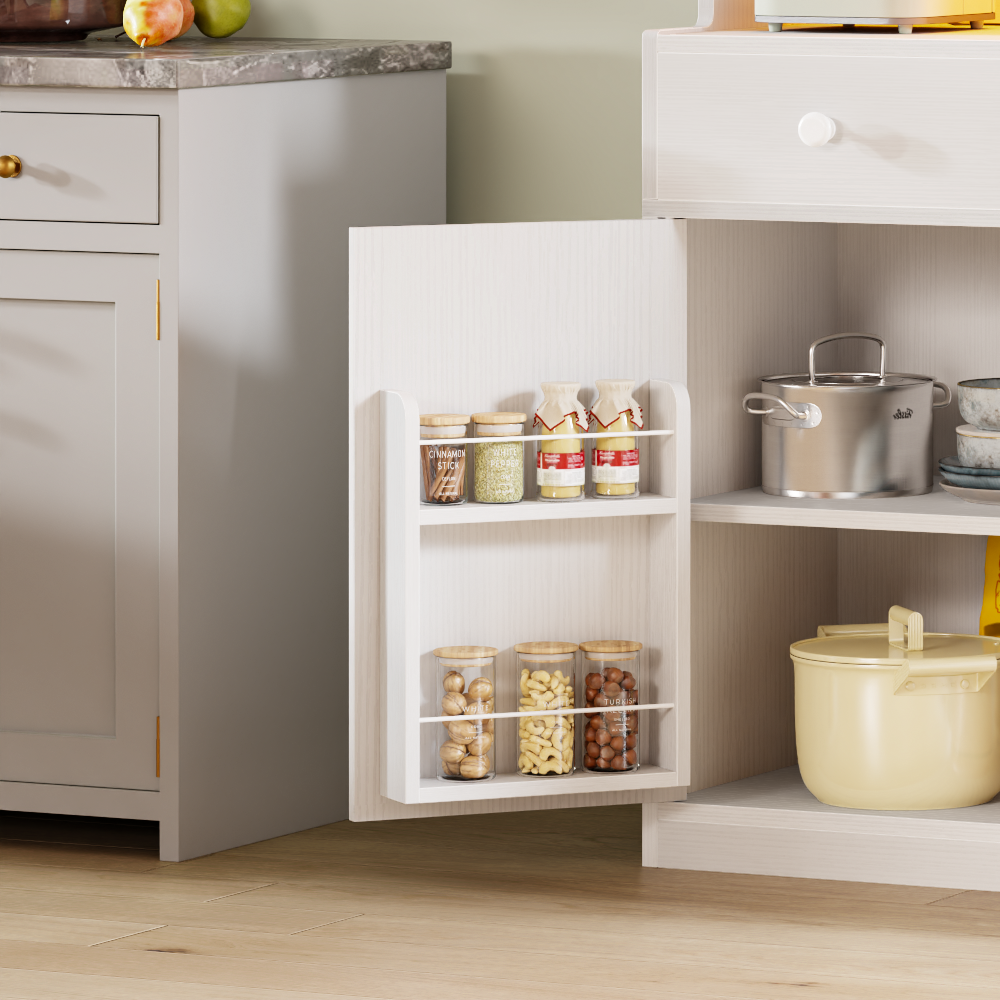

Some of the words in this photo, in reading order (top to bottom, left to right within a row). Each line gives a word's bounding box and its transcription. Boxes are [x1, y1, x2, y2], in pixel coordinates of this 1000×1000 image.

[428, 448, 466, 459] CINNAMON
[493, 447, 517, 456] WHITE
[437, 461, 460, 470] STICK
[490, 459, 520, 468] PEPPER
[604, 697, 637, 706] TURKISH
[462, 704, 489, 713] WHITE
